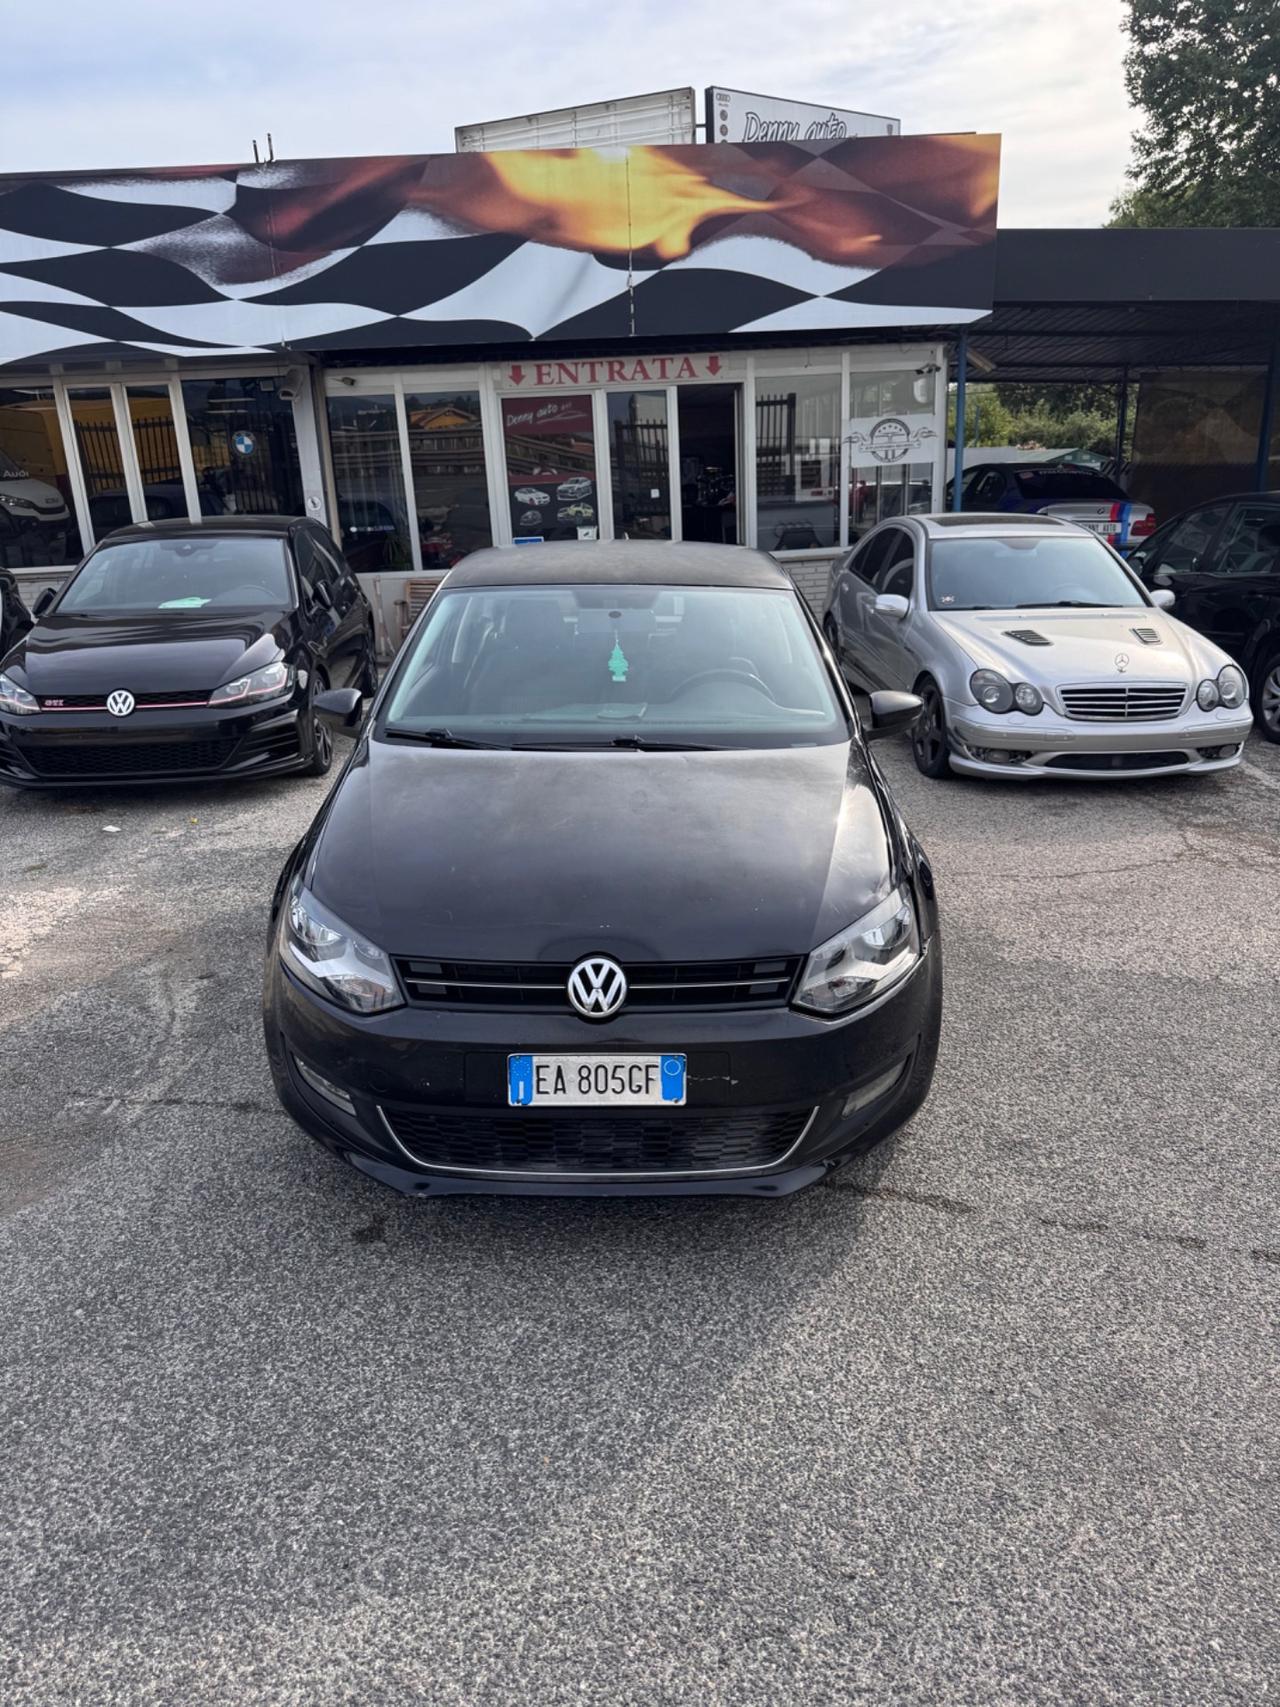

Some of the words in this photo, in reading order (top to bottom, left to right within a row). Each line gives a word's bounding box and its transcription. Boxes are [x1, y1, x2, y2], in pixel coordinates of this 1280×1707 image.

[804, 112, 847, 140] auto
[534, 357, 698, 386] ENTRATA
[506, 412, 534, 427] Denny
[535, 1065, 567, 1094] EA
[578, 1065, 660, 1094] 805GF
